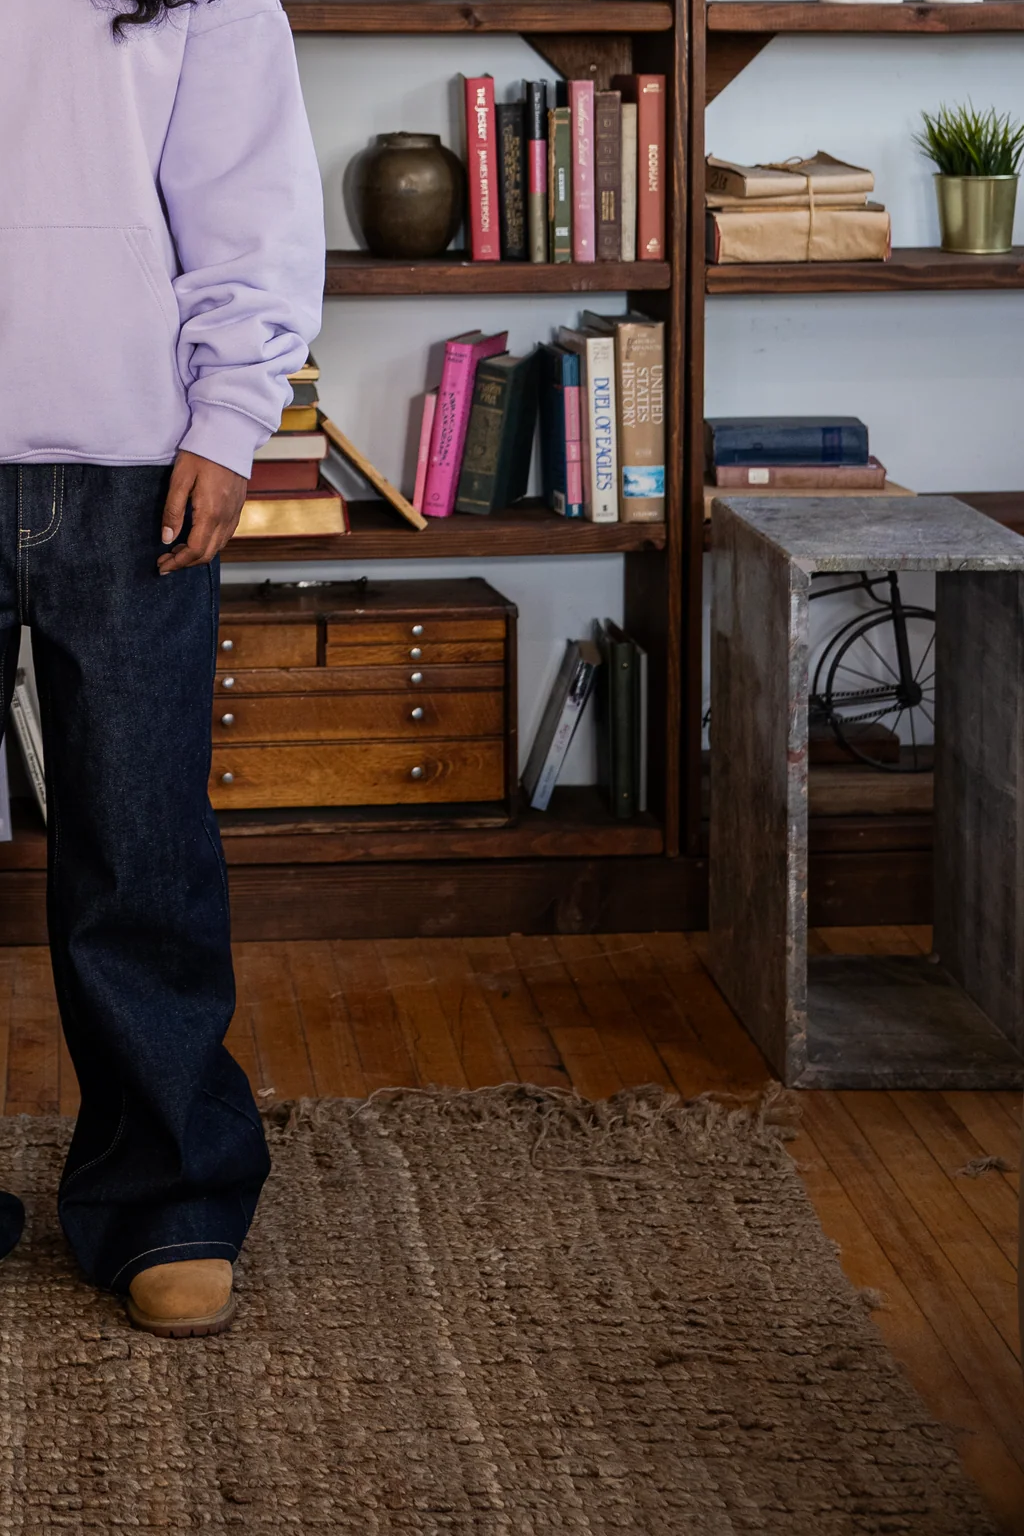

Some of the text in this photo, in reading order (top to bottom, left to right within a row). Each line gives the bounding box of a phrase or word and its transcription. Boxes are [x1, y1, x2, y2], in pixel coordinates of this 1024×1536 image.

[474, 86, 490, 233] THE Jester JAMES PATTERSON
[648, 144, 659, 192] RODHAM
[593, 377, 610, 413] DUEL
[622, 362, 635, 428] HISTORY
[636, 367, 649, 423] STATES
[650, 364, 663, 425] UNITED
[595, 415, 610, 435] OF
[596, 436, 613, 490] EAGLES
